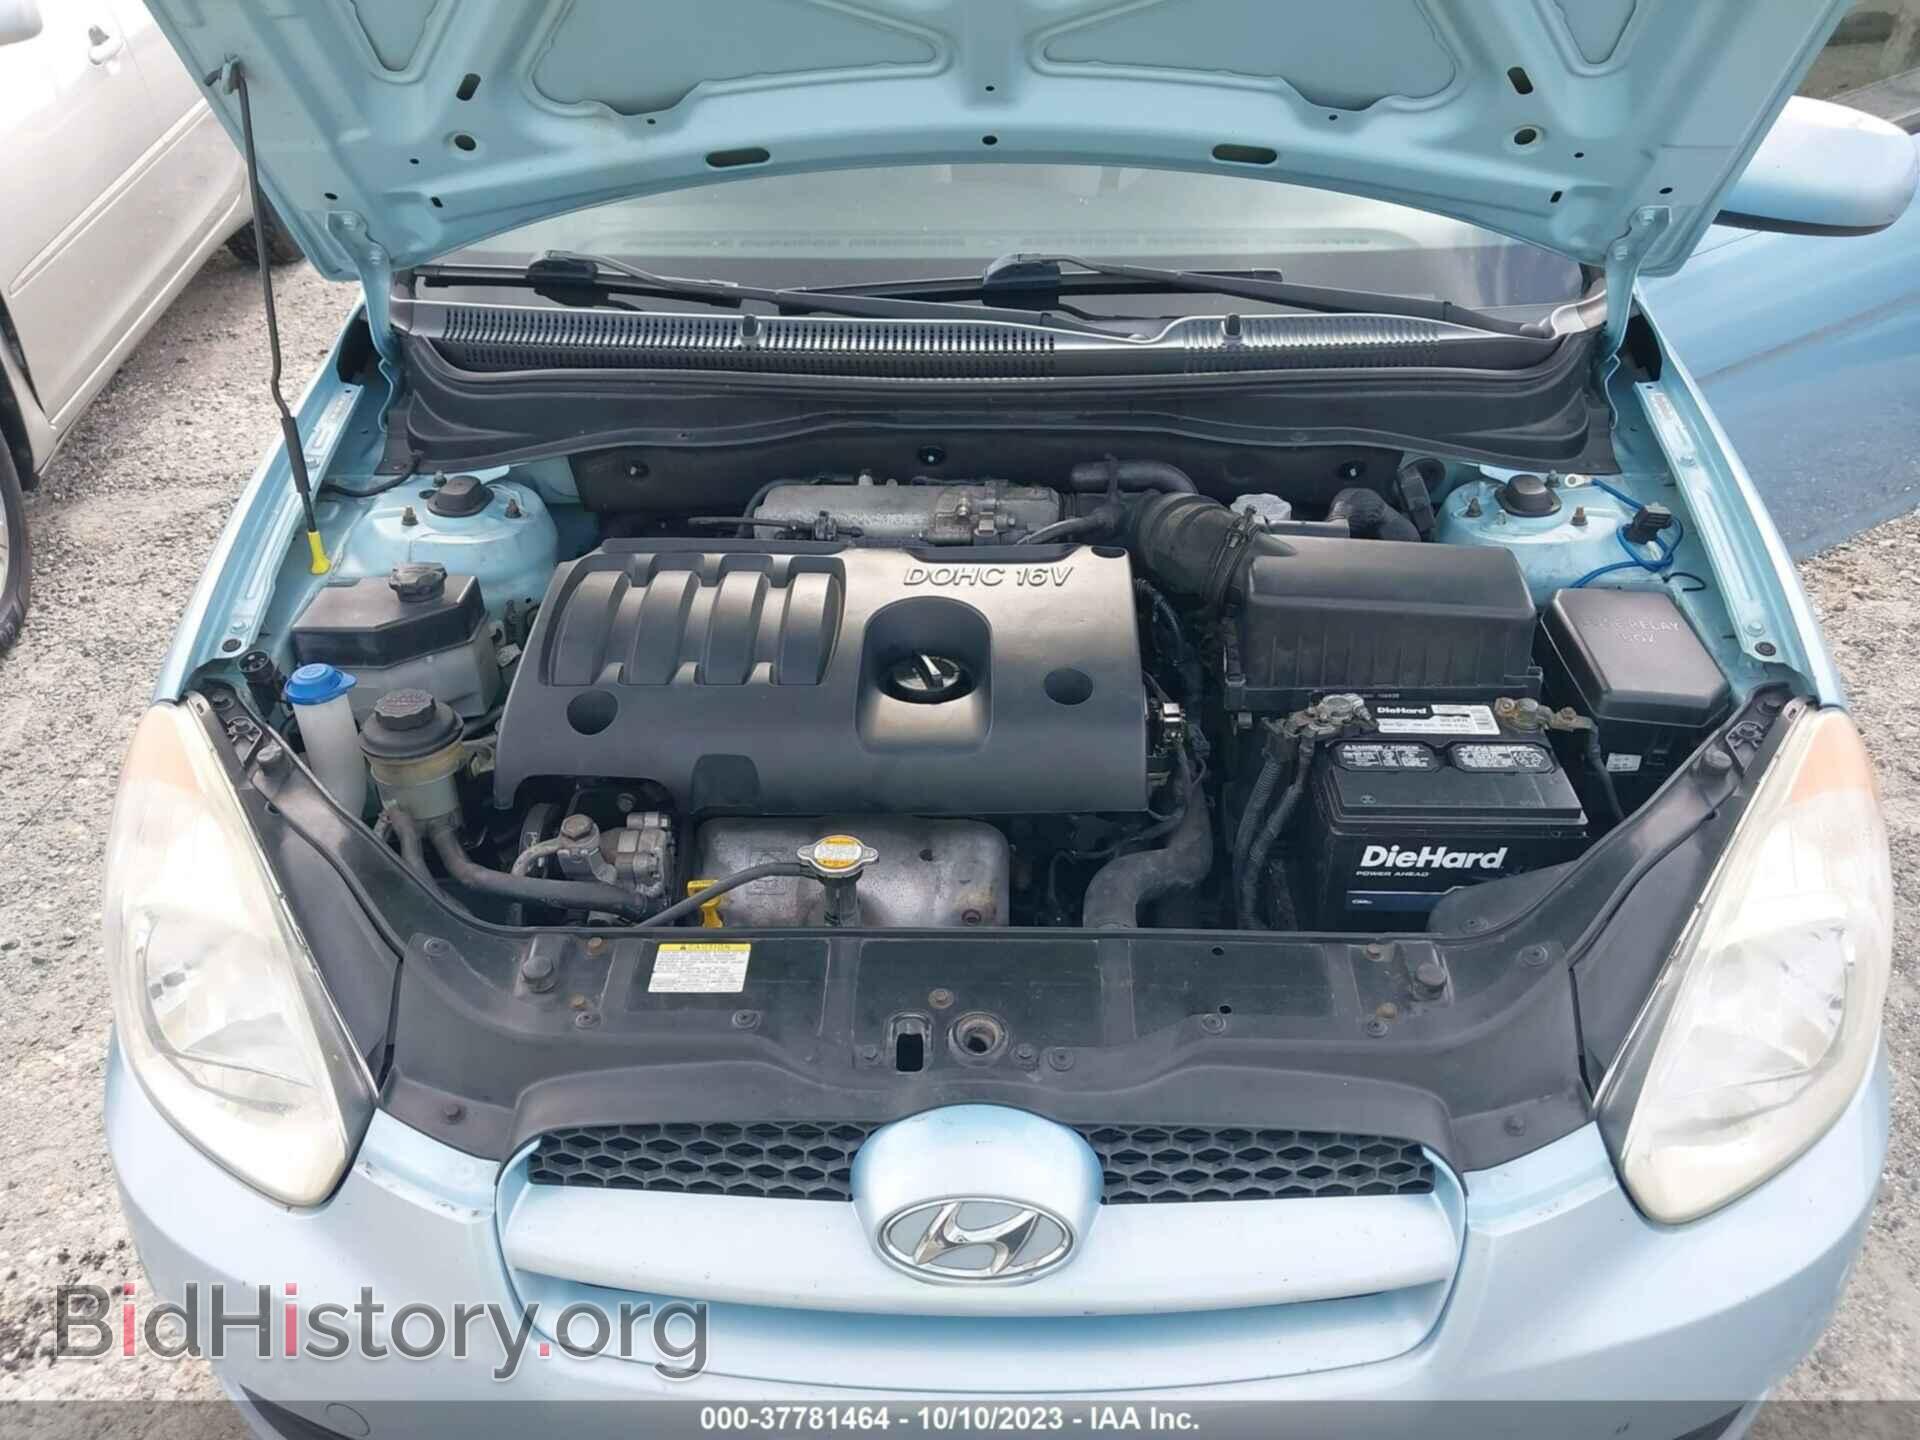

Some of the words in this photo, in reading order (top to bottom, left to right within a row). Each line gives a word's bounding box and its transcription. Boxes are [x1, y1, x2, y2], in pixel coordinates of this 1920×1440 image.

[903, 566, 1007, 587] DOHC
[1015, 566, 1073, 587] 16V
[1376, 706, 1427, 715] DieHard
[1360, 845, 1508, 869] DieHard
[1356, 870, 1392, 878] POWER
